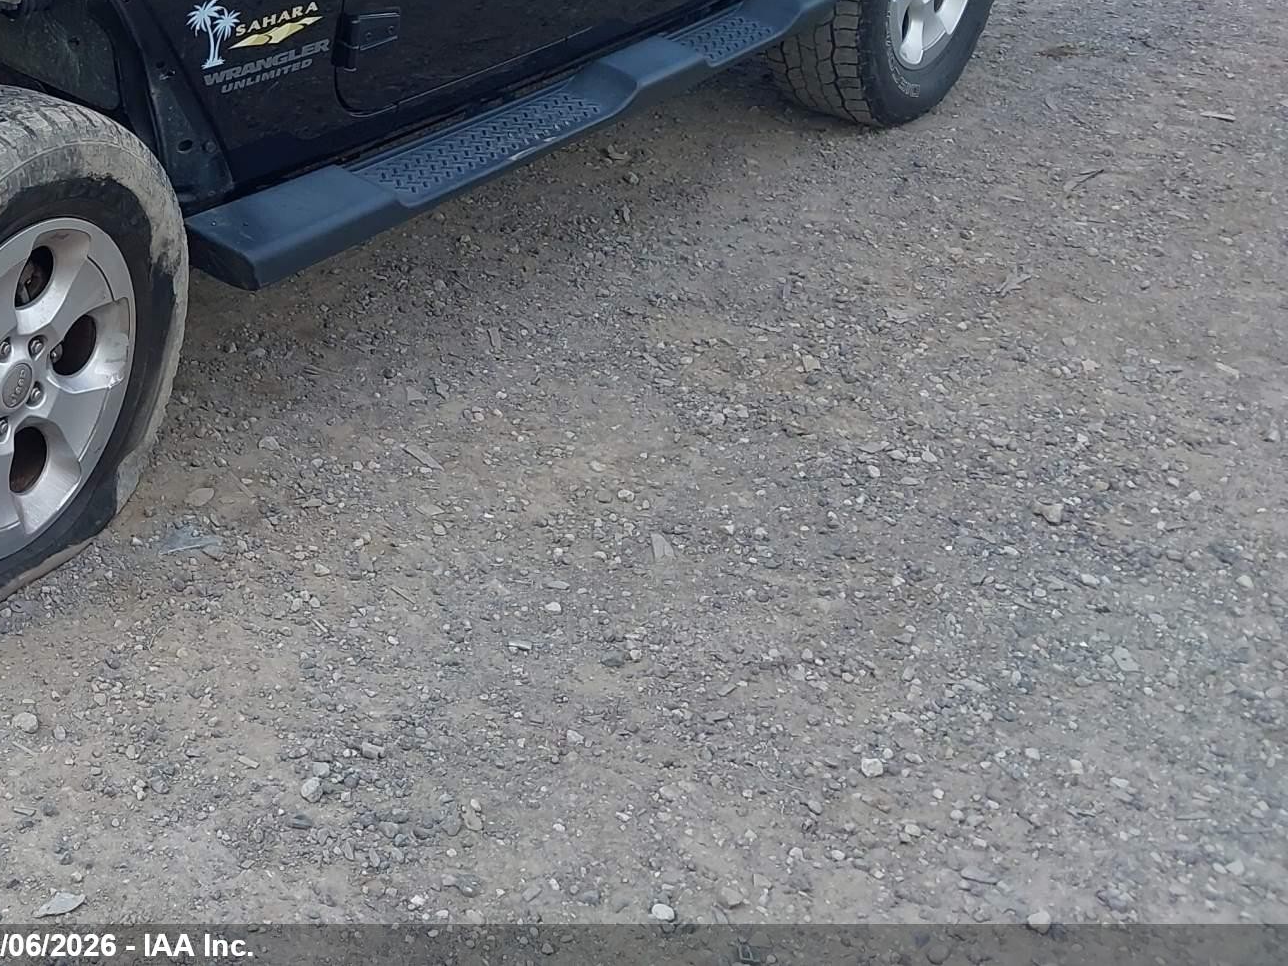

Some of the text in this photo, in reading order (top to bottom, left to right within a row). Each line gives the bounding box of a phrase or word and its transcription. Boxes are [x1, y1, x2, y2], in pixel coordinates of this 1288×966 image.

[235, 1, 320, 37] SAHARA
[203, 38, 331, 87] WRANGLER
[220, 59, 314, 94] UNLIMITED
